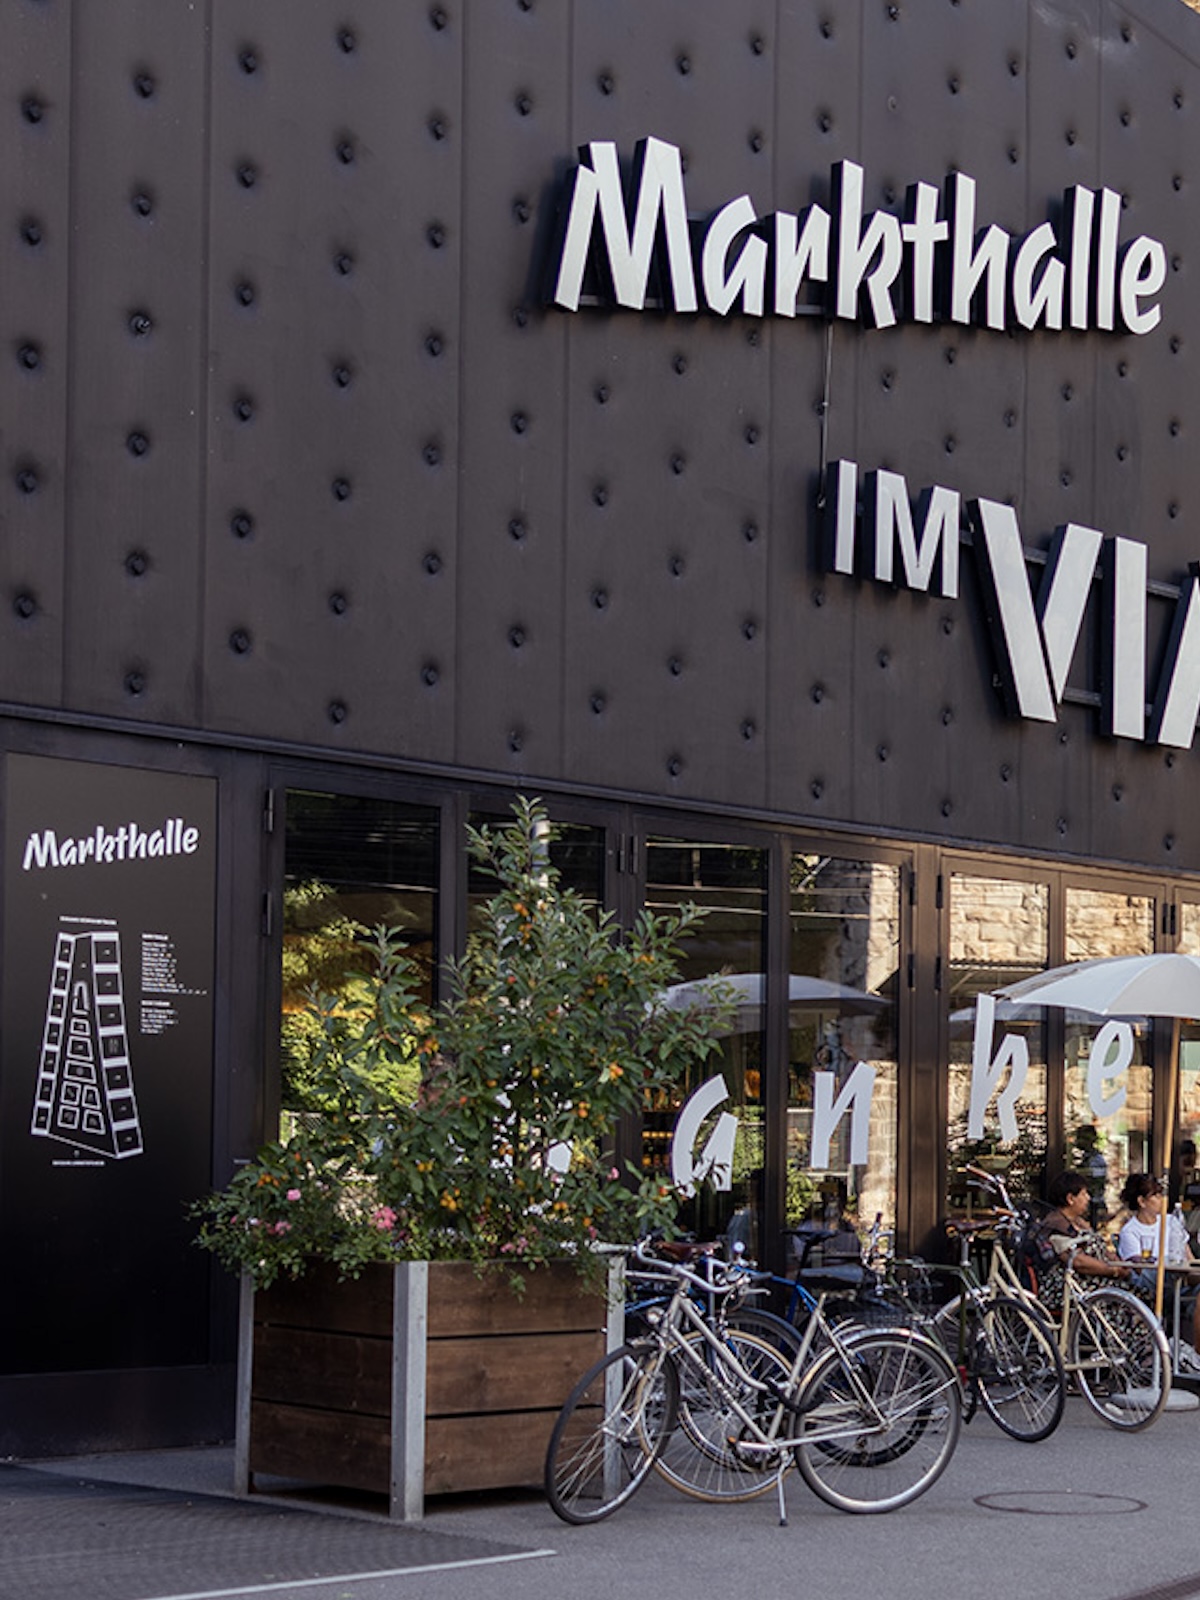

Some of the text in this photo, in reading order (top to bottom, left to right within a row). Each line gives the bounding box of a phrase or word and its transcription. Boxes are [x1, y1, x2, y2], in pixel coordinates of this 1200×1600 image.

[554, 135, 1167, 335] Markthalle
[830, 459, 960, 599] IM
[22, 818, 199, 871] Markthalle
